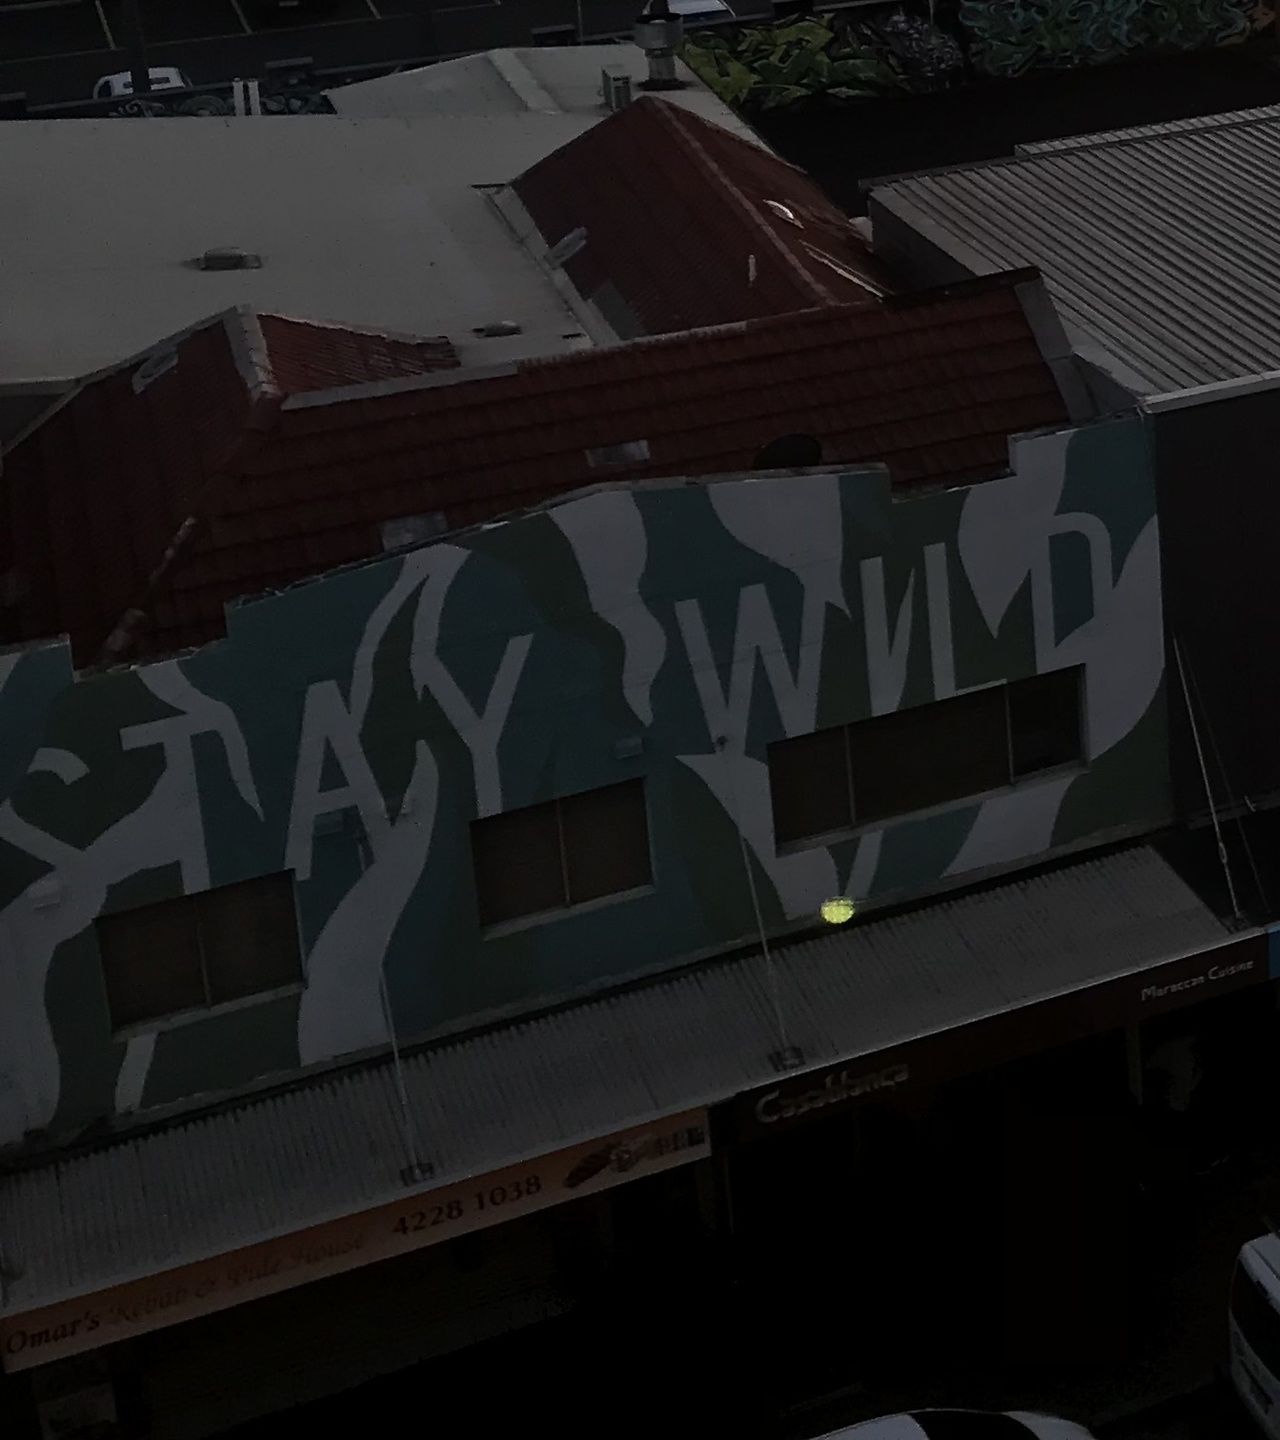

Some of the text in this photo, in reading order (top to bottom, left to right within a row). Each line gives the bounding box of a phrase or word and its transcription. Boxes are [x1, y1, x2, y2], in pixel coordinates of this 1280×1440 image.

[6, 1310, 100, 1354] Omar's
[391, 1200, 465, 1235] 4228
[473, 1174, 543, 1211] 1038
